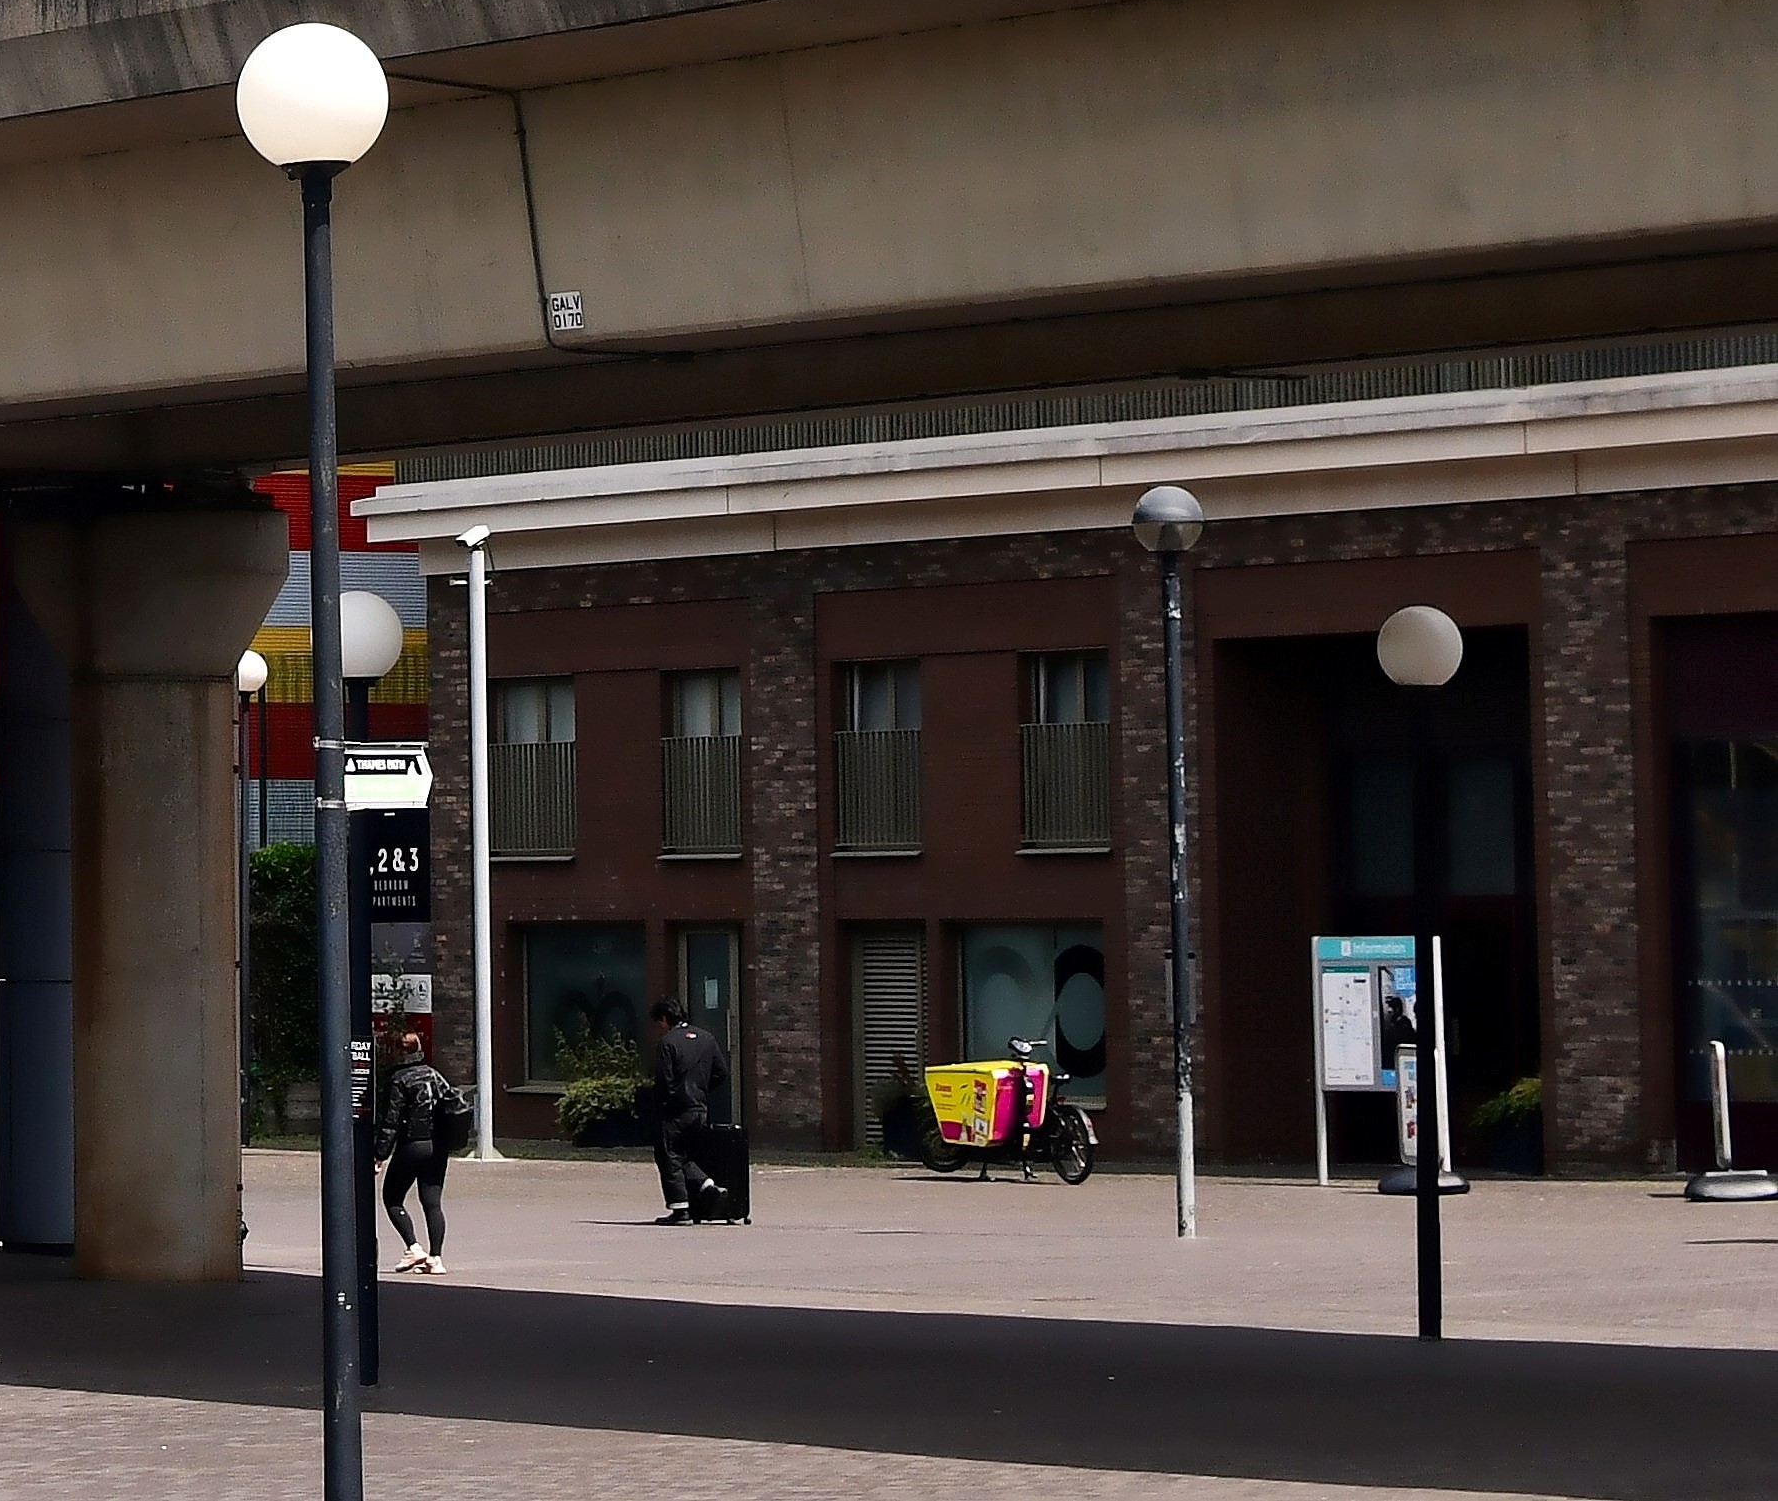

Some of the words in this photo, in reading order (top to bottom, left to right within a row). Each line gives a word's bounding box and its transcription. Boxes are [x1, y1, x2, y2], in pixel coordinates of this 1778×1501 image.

[392, 847, 406, 873] &
[409, 847, 419, 872] 3
[372, 895, 416, 907] PARTMENTS
[1352, 941, 1407, 955] Information
